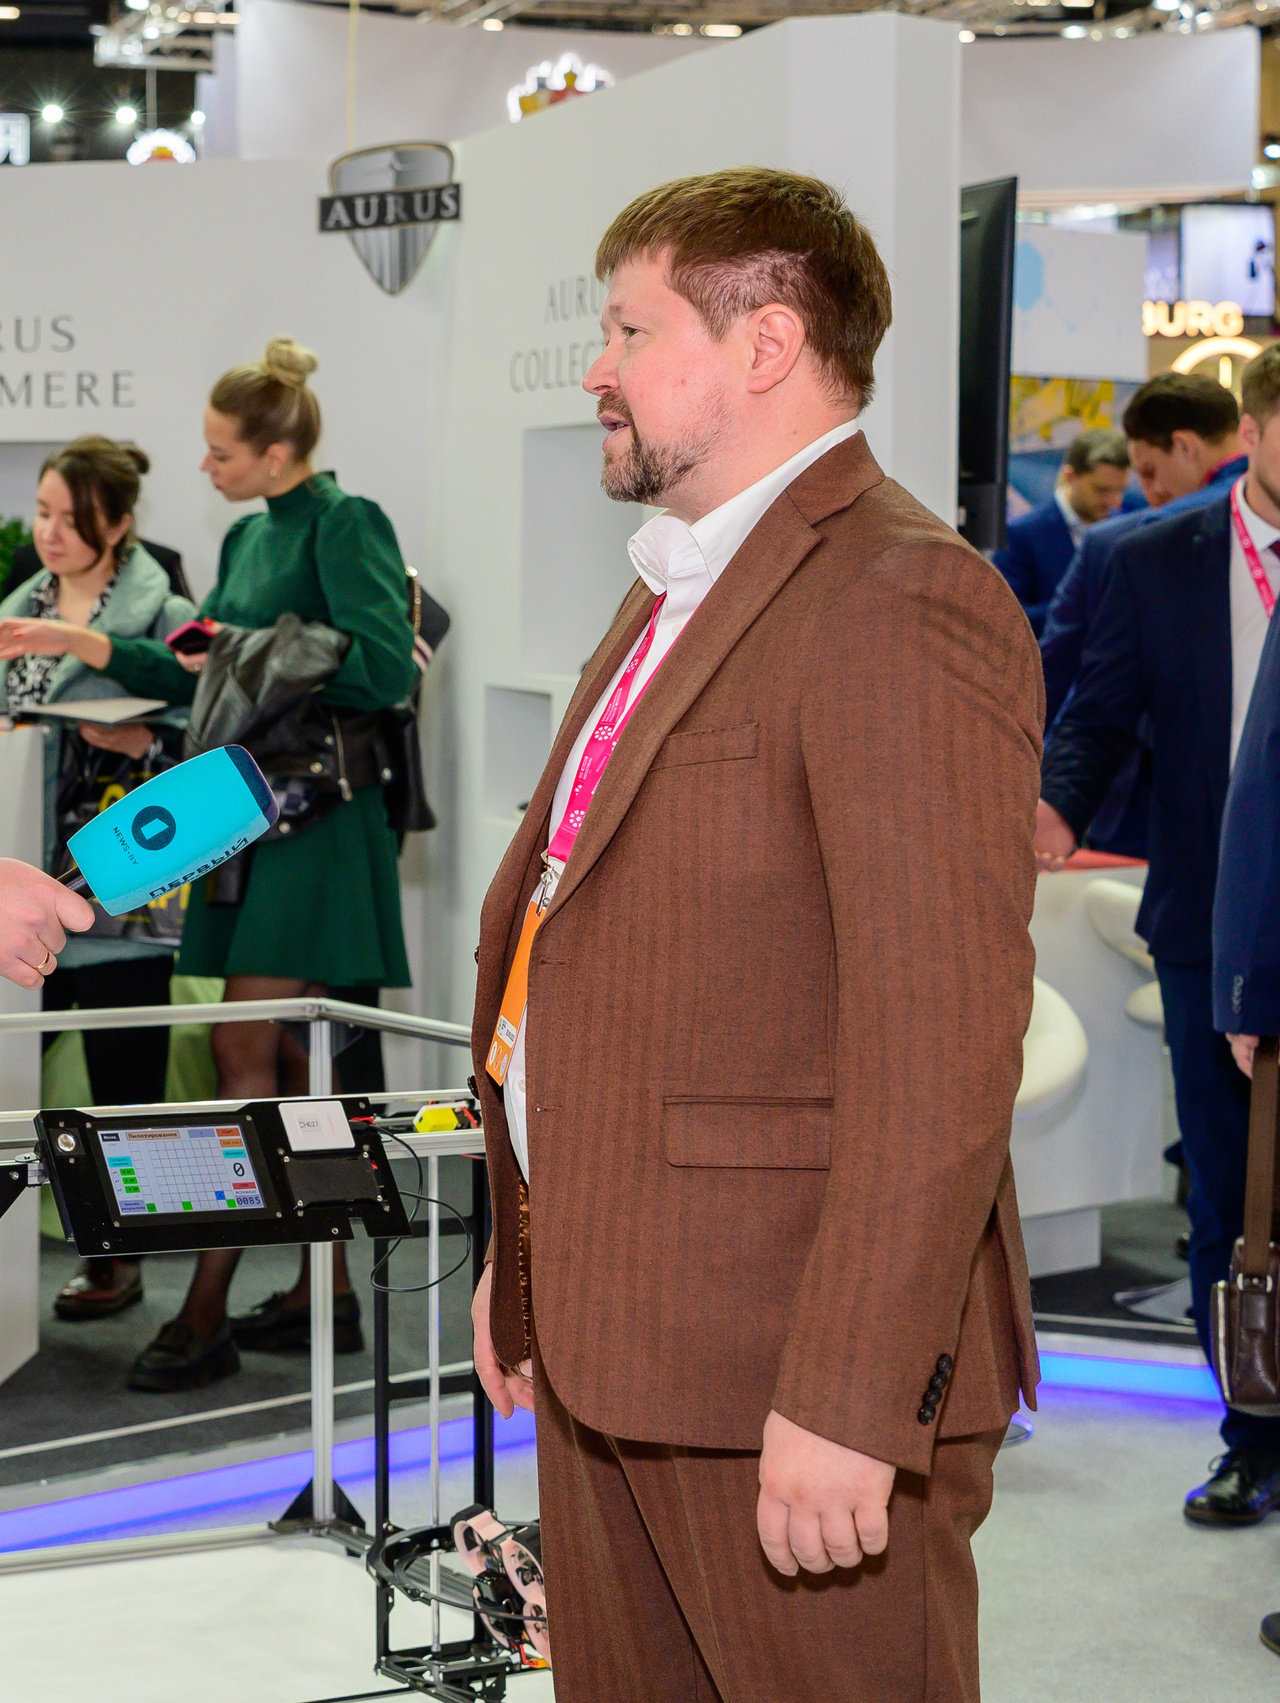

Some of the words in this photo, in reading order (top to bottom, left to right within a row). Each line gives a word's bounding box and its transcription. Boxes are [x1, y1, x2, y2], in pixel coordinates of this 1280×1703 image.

[326, 187, 458, 228] AURUS
[545, 273, 602, 323] AURU
[509, 338, 604, 393] COLLEC
[148, 837, 249, 899] ПЕРВЫЙ
[128, 1132, 178, 1140] Пилотирование
[236, 1196, 261, 1205] 0085
